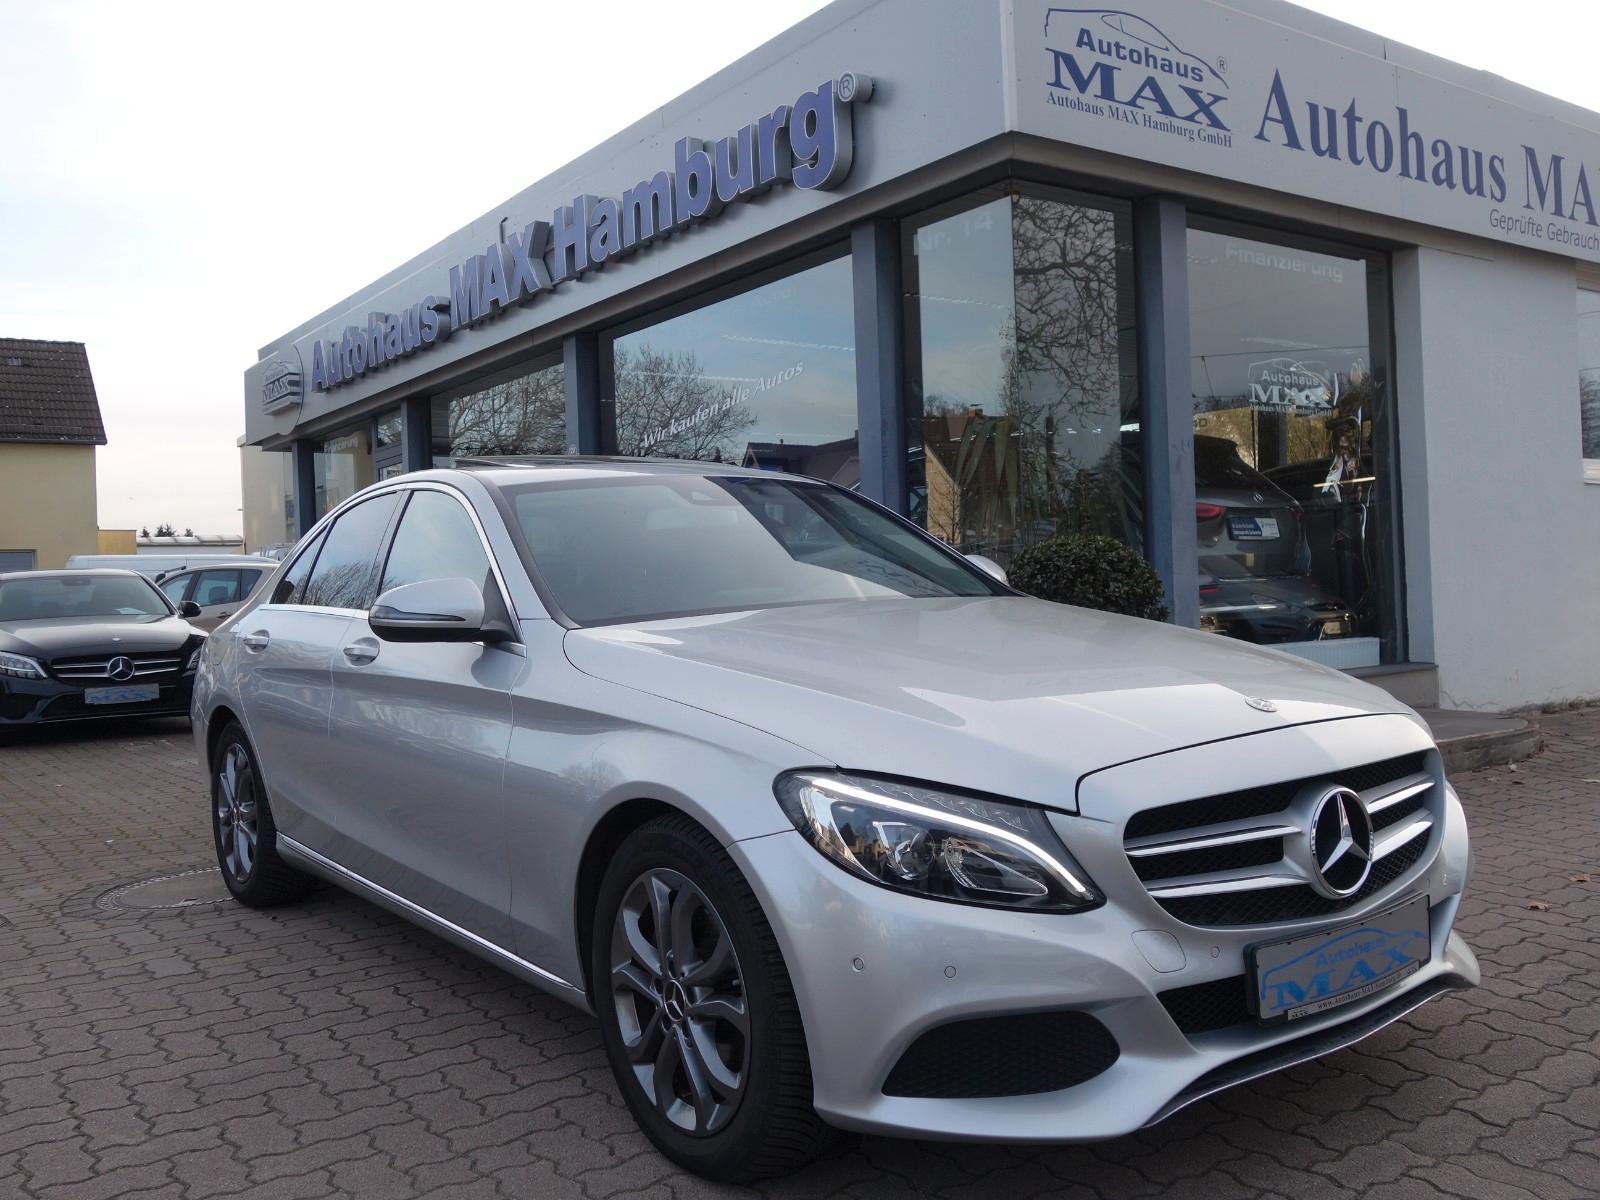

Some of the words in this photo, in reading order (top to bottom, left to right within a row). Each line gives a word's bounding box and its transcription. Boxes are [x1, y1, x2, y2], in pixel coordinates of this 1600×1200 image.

[1076, 27, 1204, 82] Autohaus
[1045, 47, 1231, 132] MAX
[1046, 90, 1105, 117] Autohaus
[1108, 105, 1140, 126] MAX
[1143, 115, 1195, 143] Hamburg
[1197, 128, 1232, 148] GmbH
[1254, 67, 1507, 203] Autohaus
[312, 295, 443, 389] Autohaus
[449, 226, 545, 331] MAX
[553, 78, 842, 283] Hamburg
[1489, 208, 1543, 239] Geprüfte
[1225, 242, 1344, 284] Finanzierung
[263, 376, 290, 401] MAX
[644, 426, 667, 448] Wir
[670, 402, 718, 436] kaufen
[722, 384, 750, 411] alle
[754, 362, 803, 395] Autos
[1262, 370, 1320, 386] Autohaus
[1268, 941, 1414, 1010] MAX
